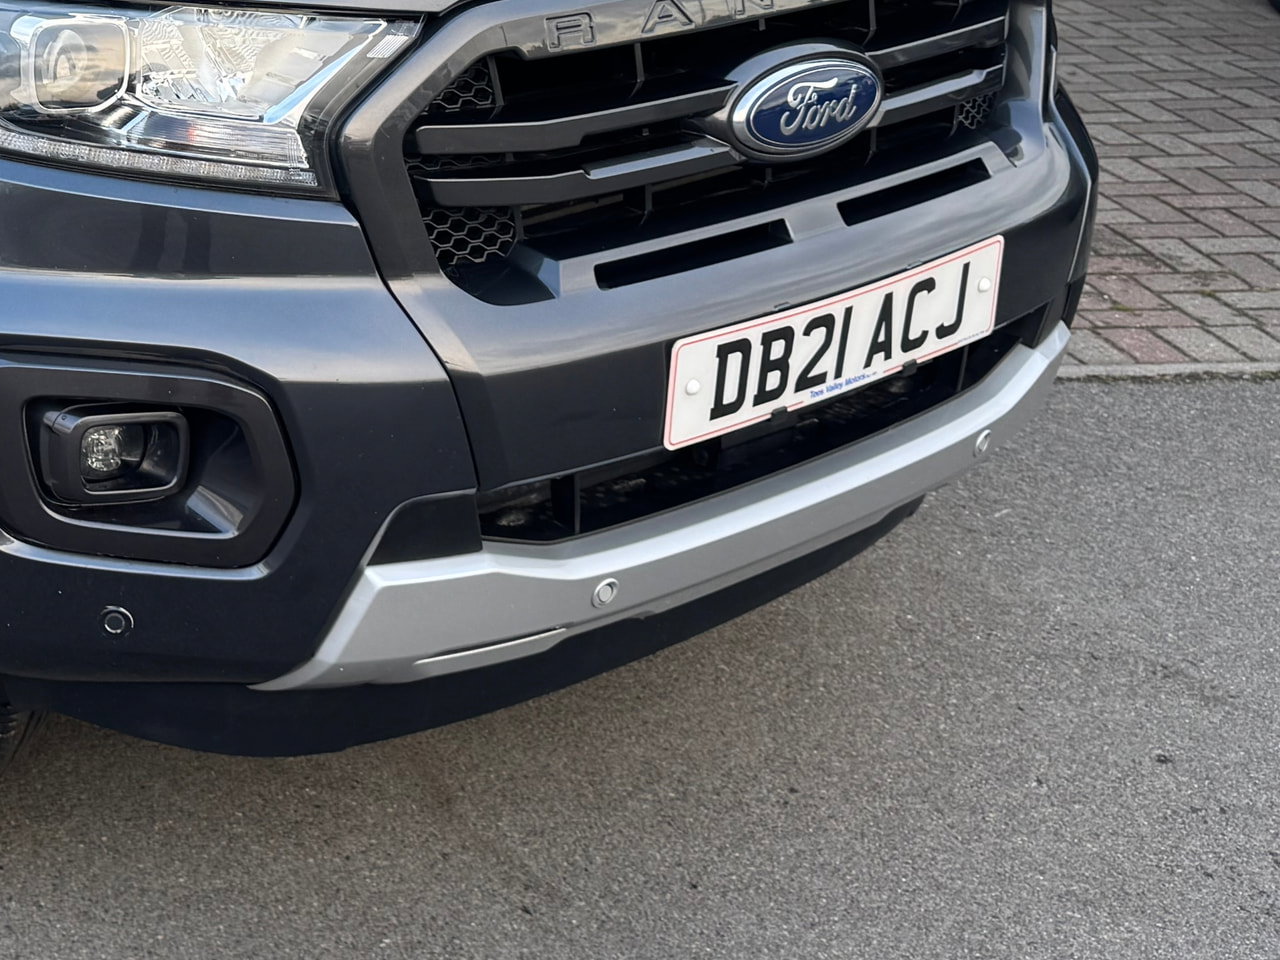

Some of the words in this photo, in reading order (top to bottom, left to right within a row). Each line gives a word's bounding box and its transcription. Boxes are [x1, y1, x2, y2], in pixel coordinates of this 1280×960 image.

[779, 76, 859, 136] Ford
[709, 305, 854, 421] DB21
[863, 261, 970, 370] ACJ
